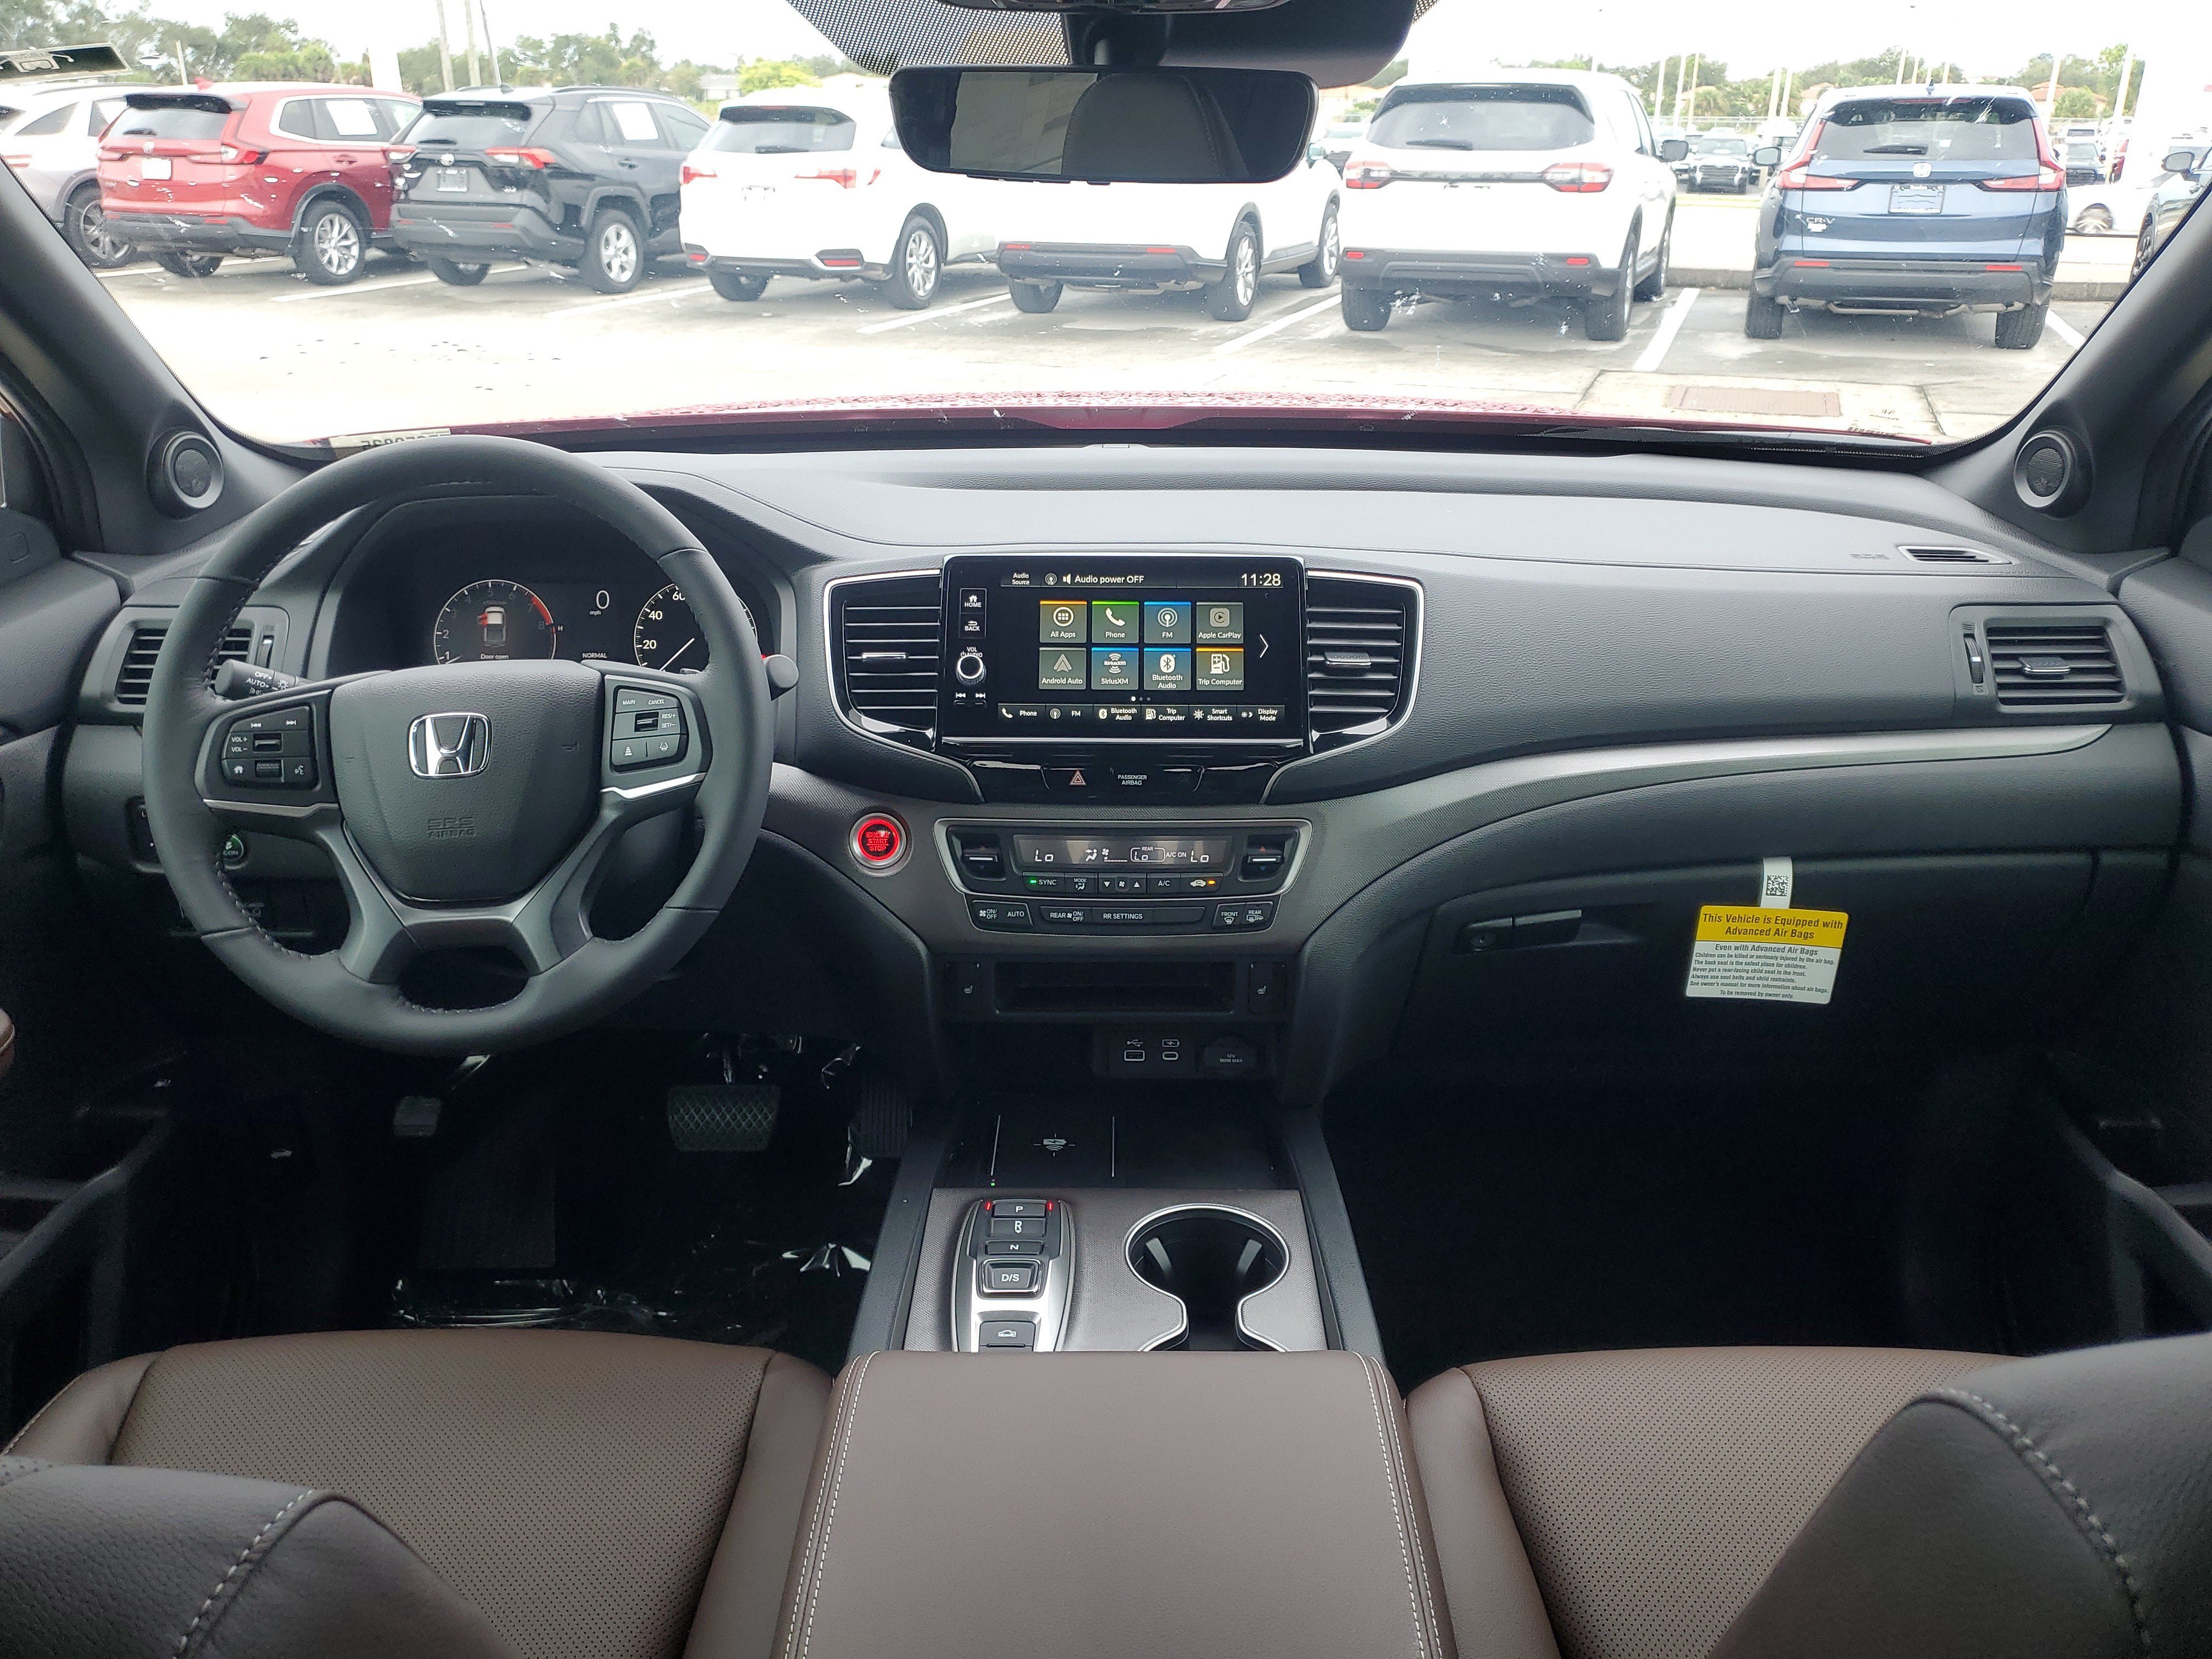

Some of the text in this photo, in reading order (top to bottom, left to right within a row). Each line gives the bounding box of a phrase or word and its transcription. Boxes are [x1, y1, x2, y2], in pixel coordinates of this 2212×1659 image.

[1075, 574, 1144, 585] Audio power OFF
[1242, 574, 1280, 586] 11:28
[596, 590, 610, 609] 0
[648, 611, 663, 620] 40
[443, 630, 449, 639] 2
[1198, 631, 1242, 640] Apple CarPlay
[643, 640, 657, 649] 20
[445, 651, 450, 660] 1
[1101, 677, 1128, 685] SiriusXM
[1152, 673, 1183, 681] Bluetooth
[246, 678, 266, 688] AUTO
[1198, 678, 1242, 686] Trip Computer
[1035, 849, 1053, 862] Lo
[1134, 852, 1148, 861] Lo
[1191, 850, 1209, 862] Lo
[1702, 913, 1843, 929] This Vehicle is Equipped with
[1725, 927, 1814, 940] Advanced Air Bags
[1750, 944, 1786, 953] Advanced
[1015, 1221, 1022, 1230] R
